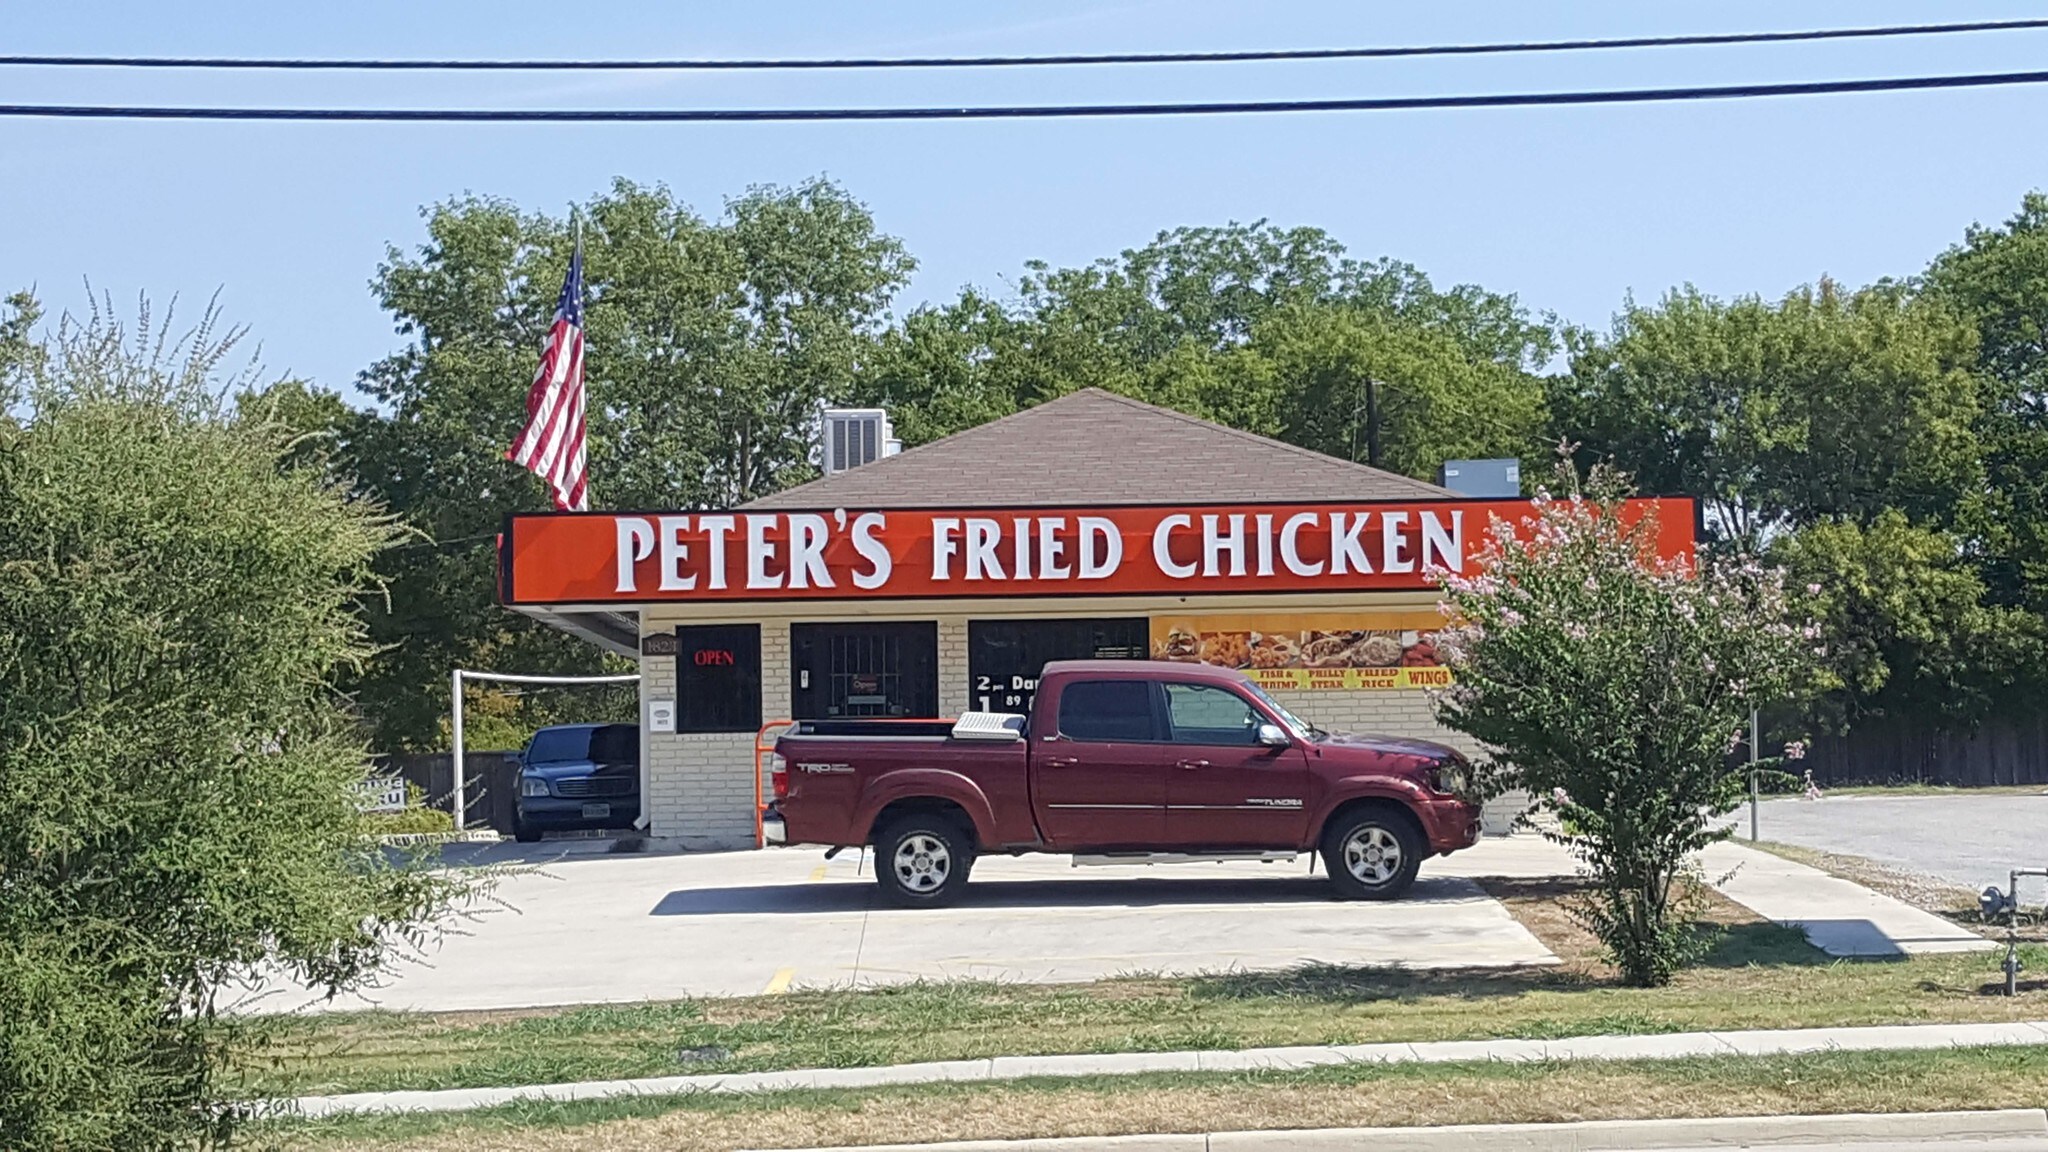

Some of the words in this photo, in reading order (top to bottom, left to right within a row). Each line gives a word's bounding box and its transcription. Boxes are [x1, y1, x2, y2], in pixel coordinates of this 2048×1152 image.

[614, 508, 893, 592] PETER'S
[931, 517, 1123, 581] FRIED
[1153, 510, 1463, 579] CHICKEN
[694, 650, 734, 666] OPEN
[1259, 670, 1284, 678] FISH
[1308, 669, 1346, 678] PHILLY
[1356, 668, 1399, 677] FRIED
[1408, 670, 1449, 685] WINGS
[977, 675, 991, 690] 2
[1311, 680, 1345, 689] STEAK
[1361, 679, 1394, 688] RICE
[1006, 695, 1021, 706] 89
[1264, 798, 1303, 806] TUNDRA
